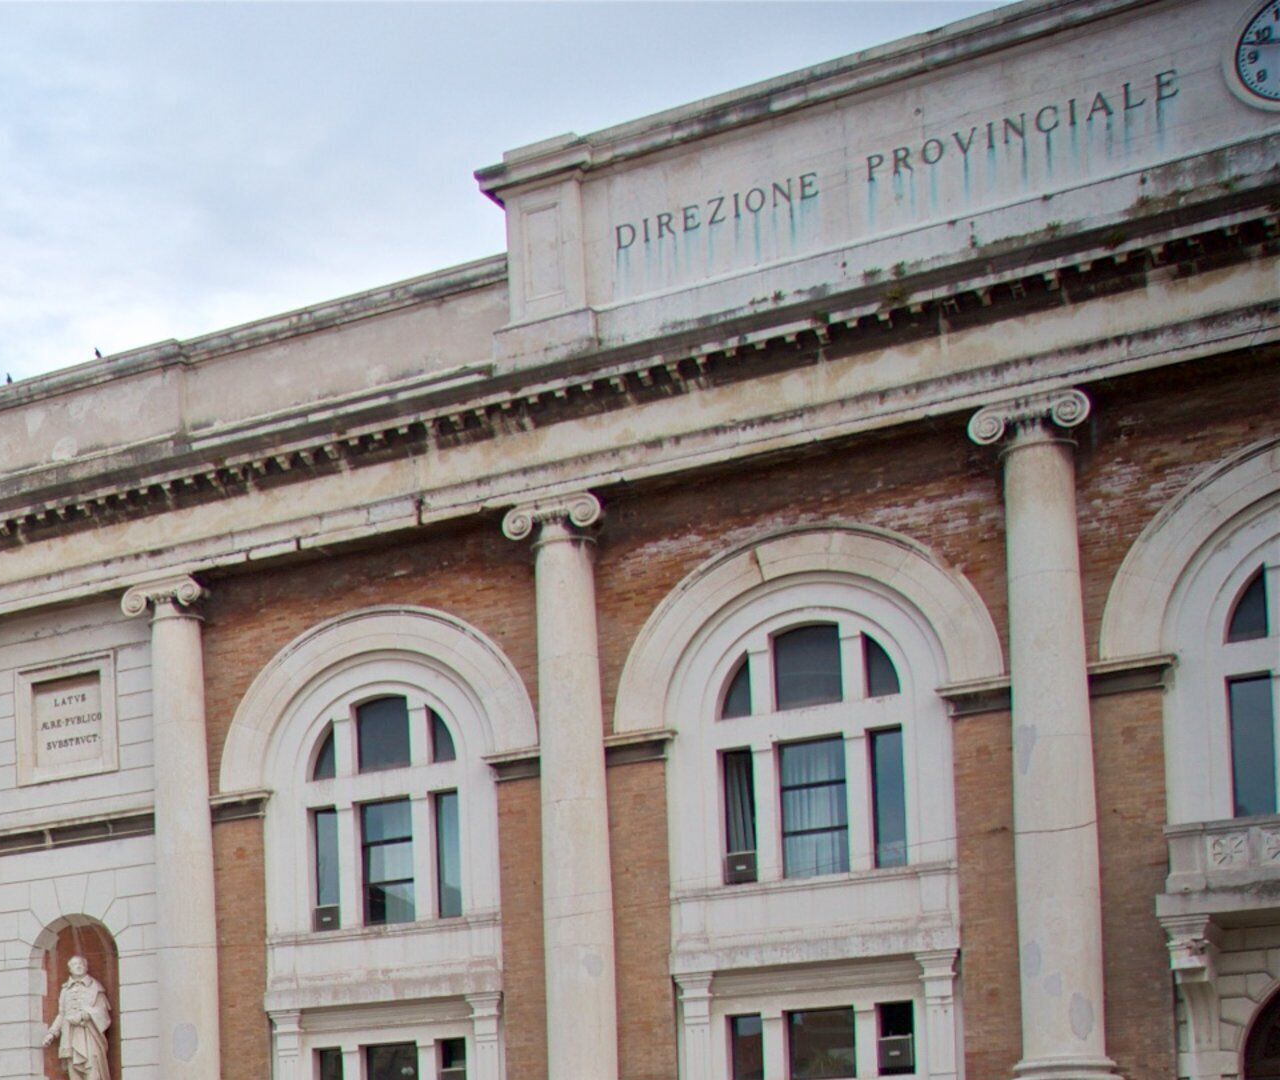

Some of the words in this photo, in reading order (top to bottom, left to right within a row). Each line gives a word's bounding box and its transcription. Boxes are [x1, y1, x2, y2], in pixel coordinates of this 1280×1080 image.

[1255, 26, 1272, 41] 10
[1248, 51, 1259, 64] 9
[1256, 69, 1267, 83] 8
[615, 172, 819, 249] DIREZIONE
[866, 68, 1179, 182] PROVINCIALE
[54, 693, 86, 707] LATVS
